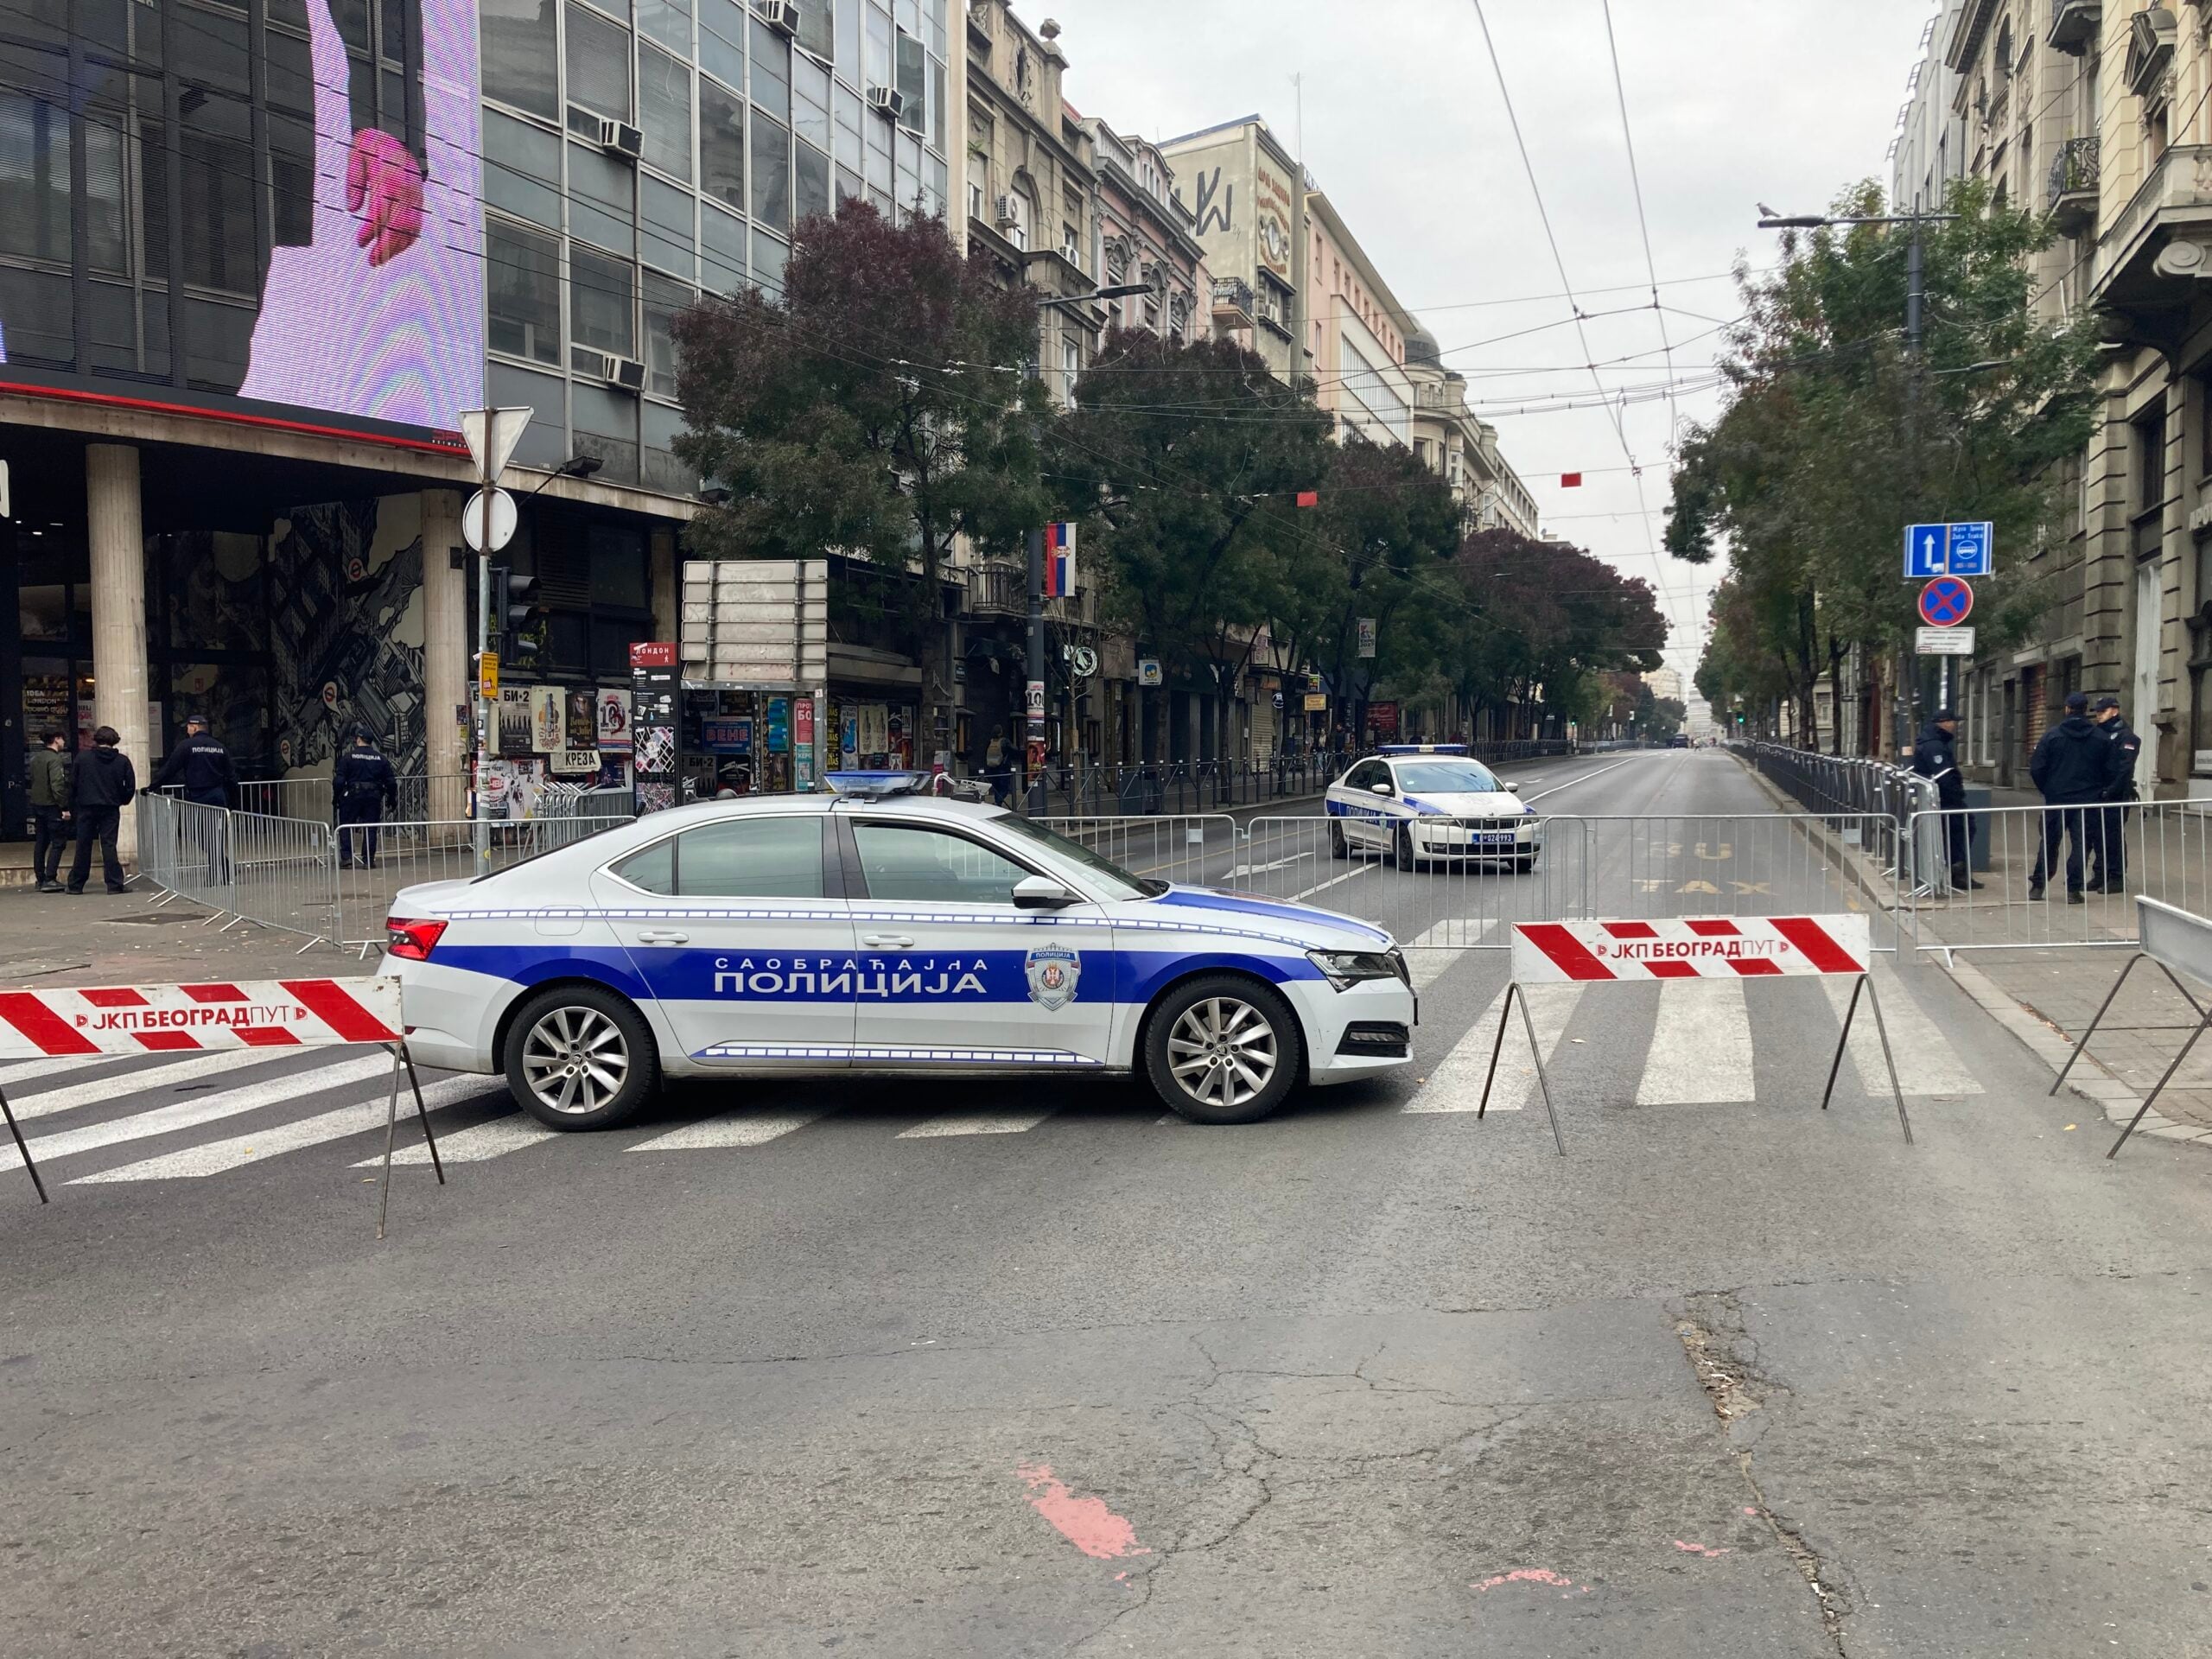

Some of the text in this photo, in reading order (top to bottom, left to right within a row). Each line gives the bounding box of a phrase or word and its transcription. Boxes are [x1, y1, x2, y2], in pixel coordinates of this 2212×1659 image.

[1611, 939, 1776, 958] ЈКП БЕОГРАДПУТ
[714, 972, 988, 997] ПОЛИЦИЈА
[92, 1005, 289, 1030] ЈКП БЕОГРАДПУТ
